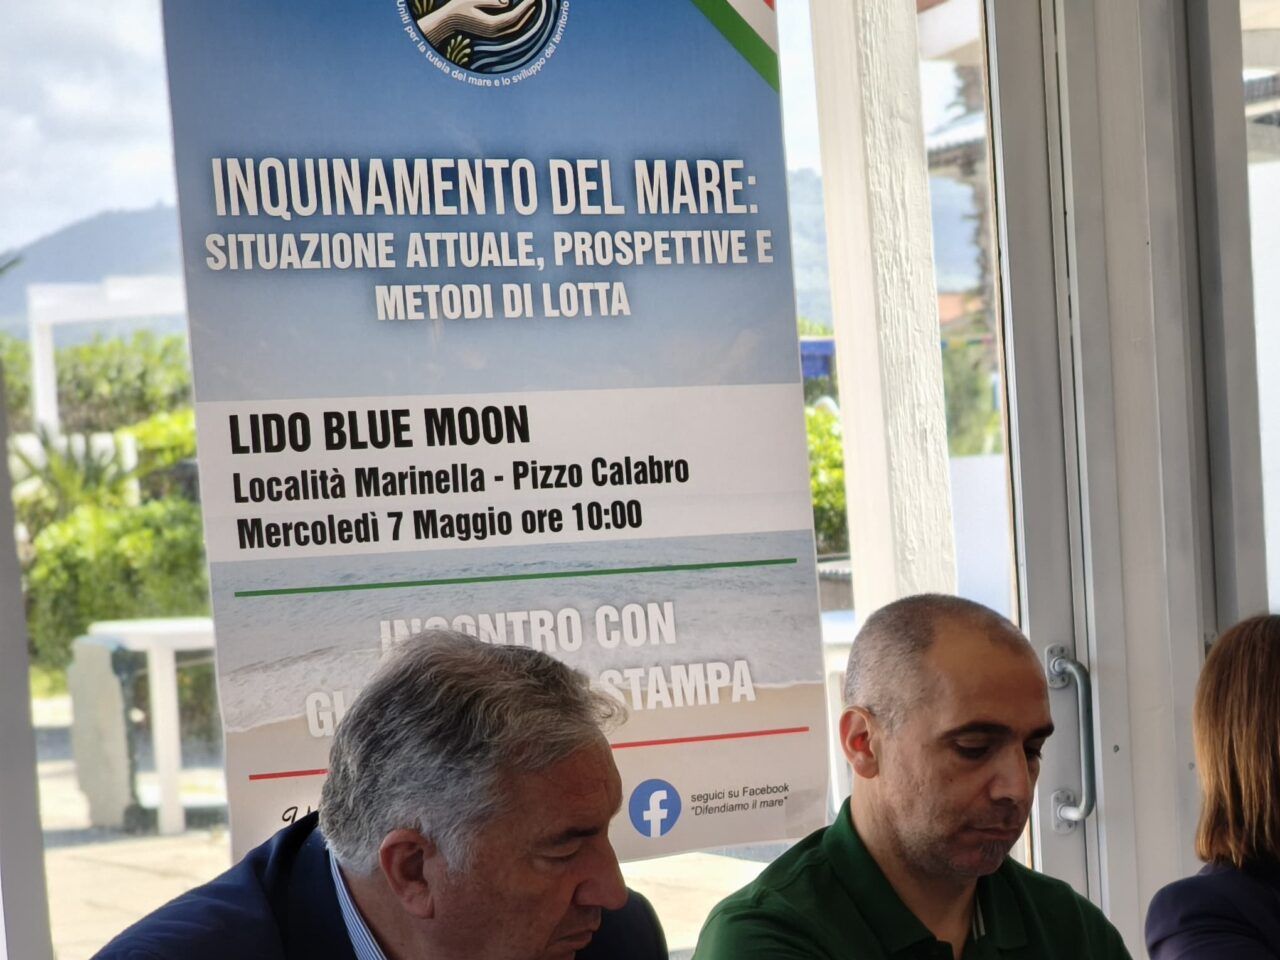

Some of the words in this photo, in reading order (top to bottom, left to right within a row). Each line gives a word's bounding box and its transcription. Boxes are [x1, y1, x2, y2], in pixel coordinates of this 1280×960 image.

[211, 157, 538, 221] INQUINAMENTO
[550, 159, 626, 214] DEL
[635, 158, 759, 214] MARE:
[205, 232, 395, 271] SITUAZIONE
[406, 231, 545, 272] ATTUALE,
[553, 229, 747, 266] PROSPETTIVE
[756, 229, 774, 264] E
[375, 284, 494, 321] METODI
[503, 283, 533, 318] DI
[542, 281, 631, 318] LOTTA
[229, 411, 311, 455] LIDO
[323, 408, 412, 451] BLUE
[424, 405, 530, 447] MOON
[232, 467, 346, 503] Località
[354, 462, 485, 499] Marinella
[512, 459, 583, 490] Pizzo
[591, 454, 689, 486] Calabro
[236, 512, 380, 549] Mercoledì
[387, 511, 403, 541] 7
[413, 507, 512, 543] Maggio
[521, 506, 563, 534] ore
[572, 499, 642, 531] 10:00
[595, 601, 676, 648] CON
[599, 659, 756, 711] STAMPA
[691, 791, 725, 804] seguici
[728, 789, 740, 798] su
[742, 783, 790, 797] Facebook
